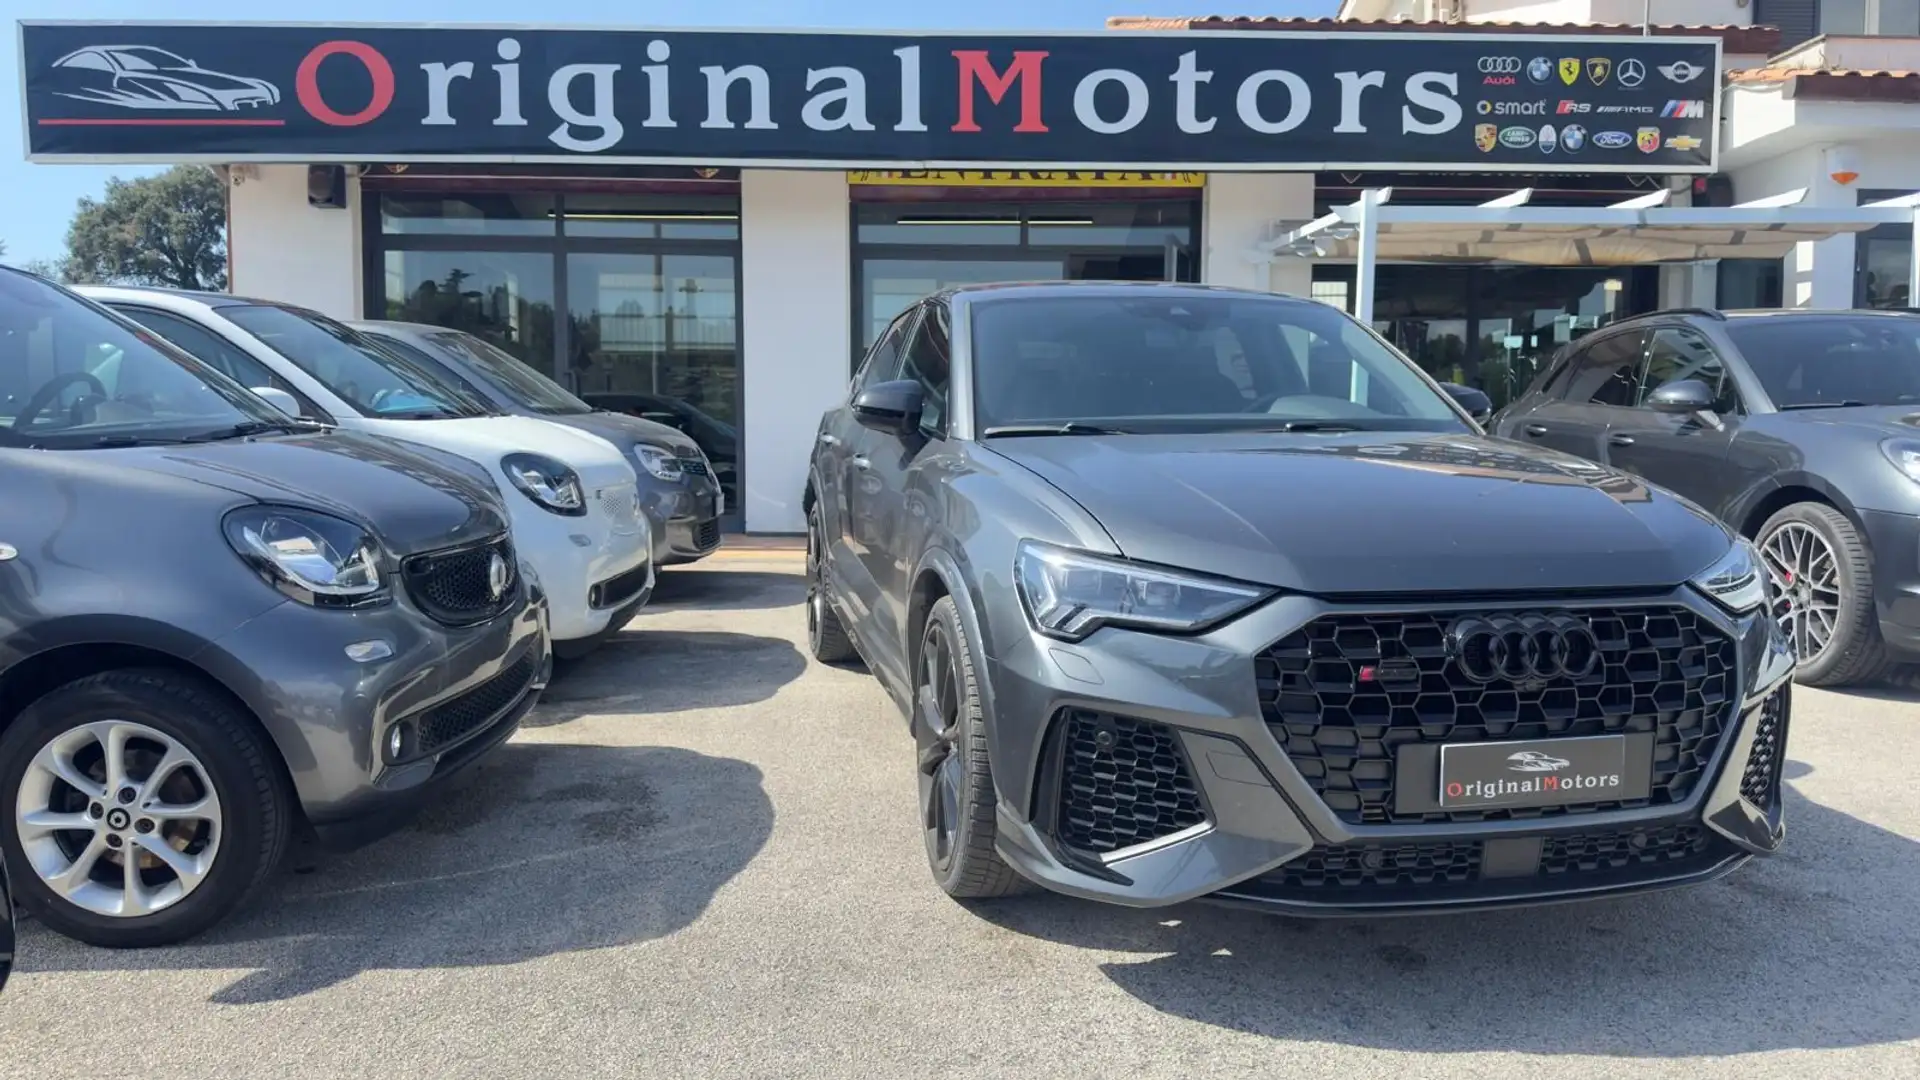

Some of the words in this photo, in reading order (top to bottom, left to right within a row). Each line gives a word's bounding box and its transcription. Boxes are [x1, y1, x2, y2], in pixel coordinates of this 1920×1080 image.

[1483, 76, 1516, 85] Audi
[1495, 101, 1546, 115] smart
[1446, 774, 1620, 798] OriginalMotors
